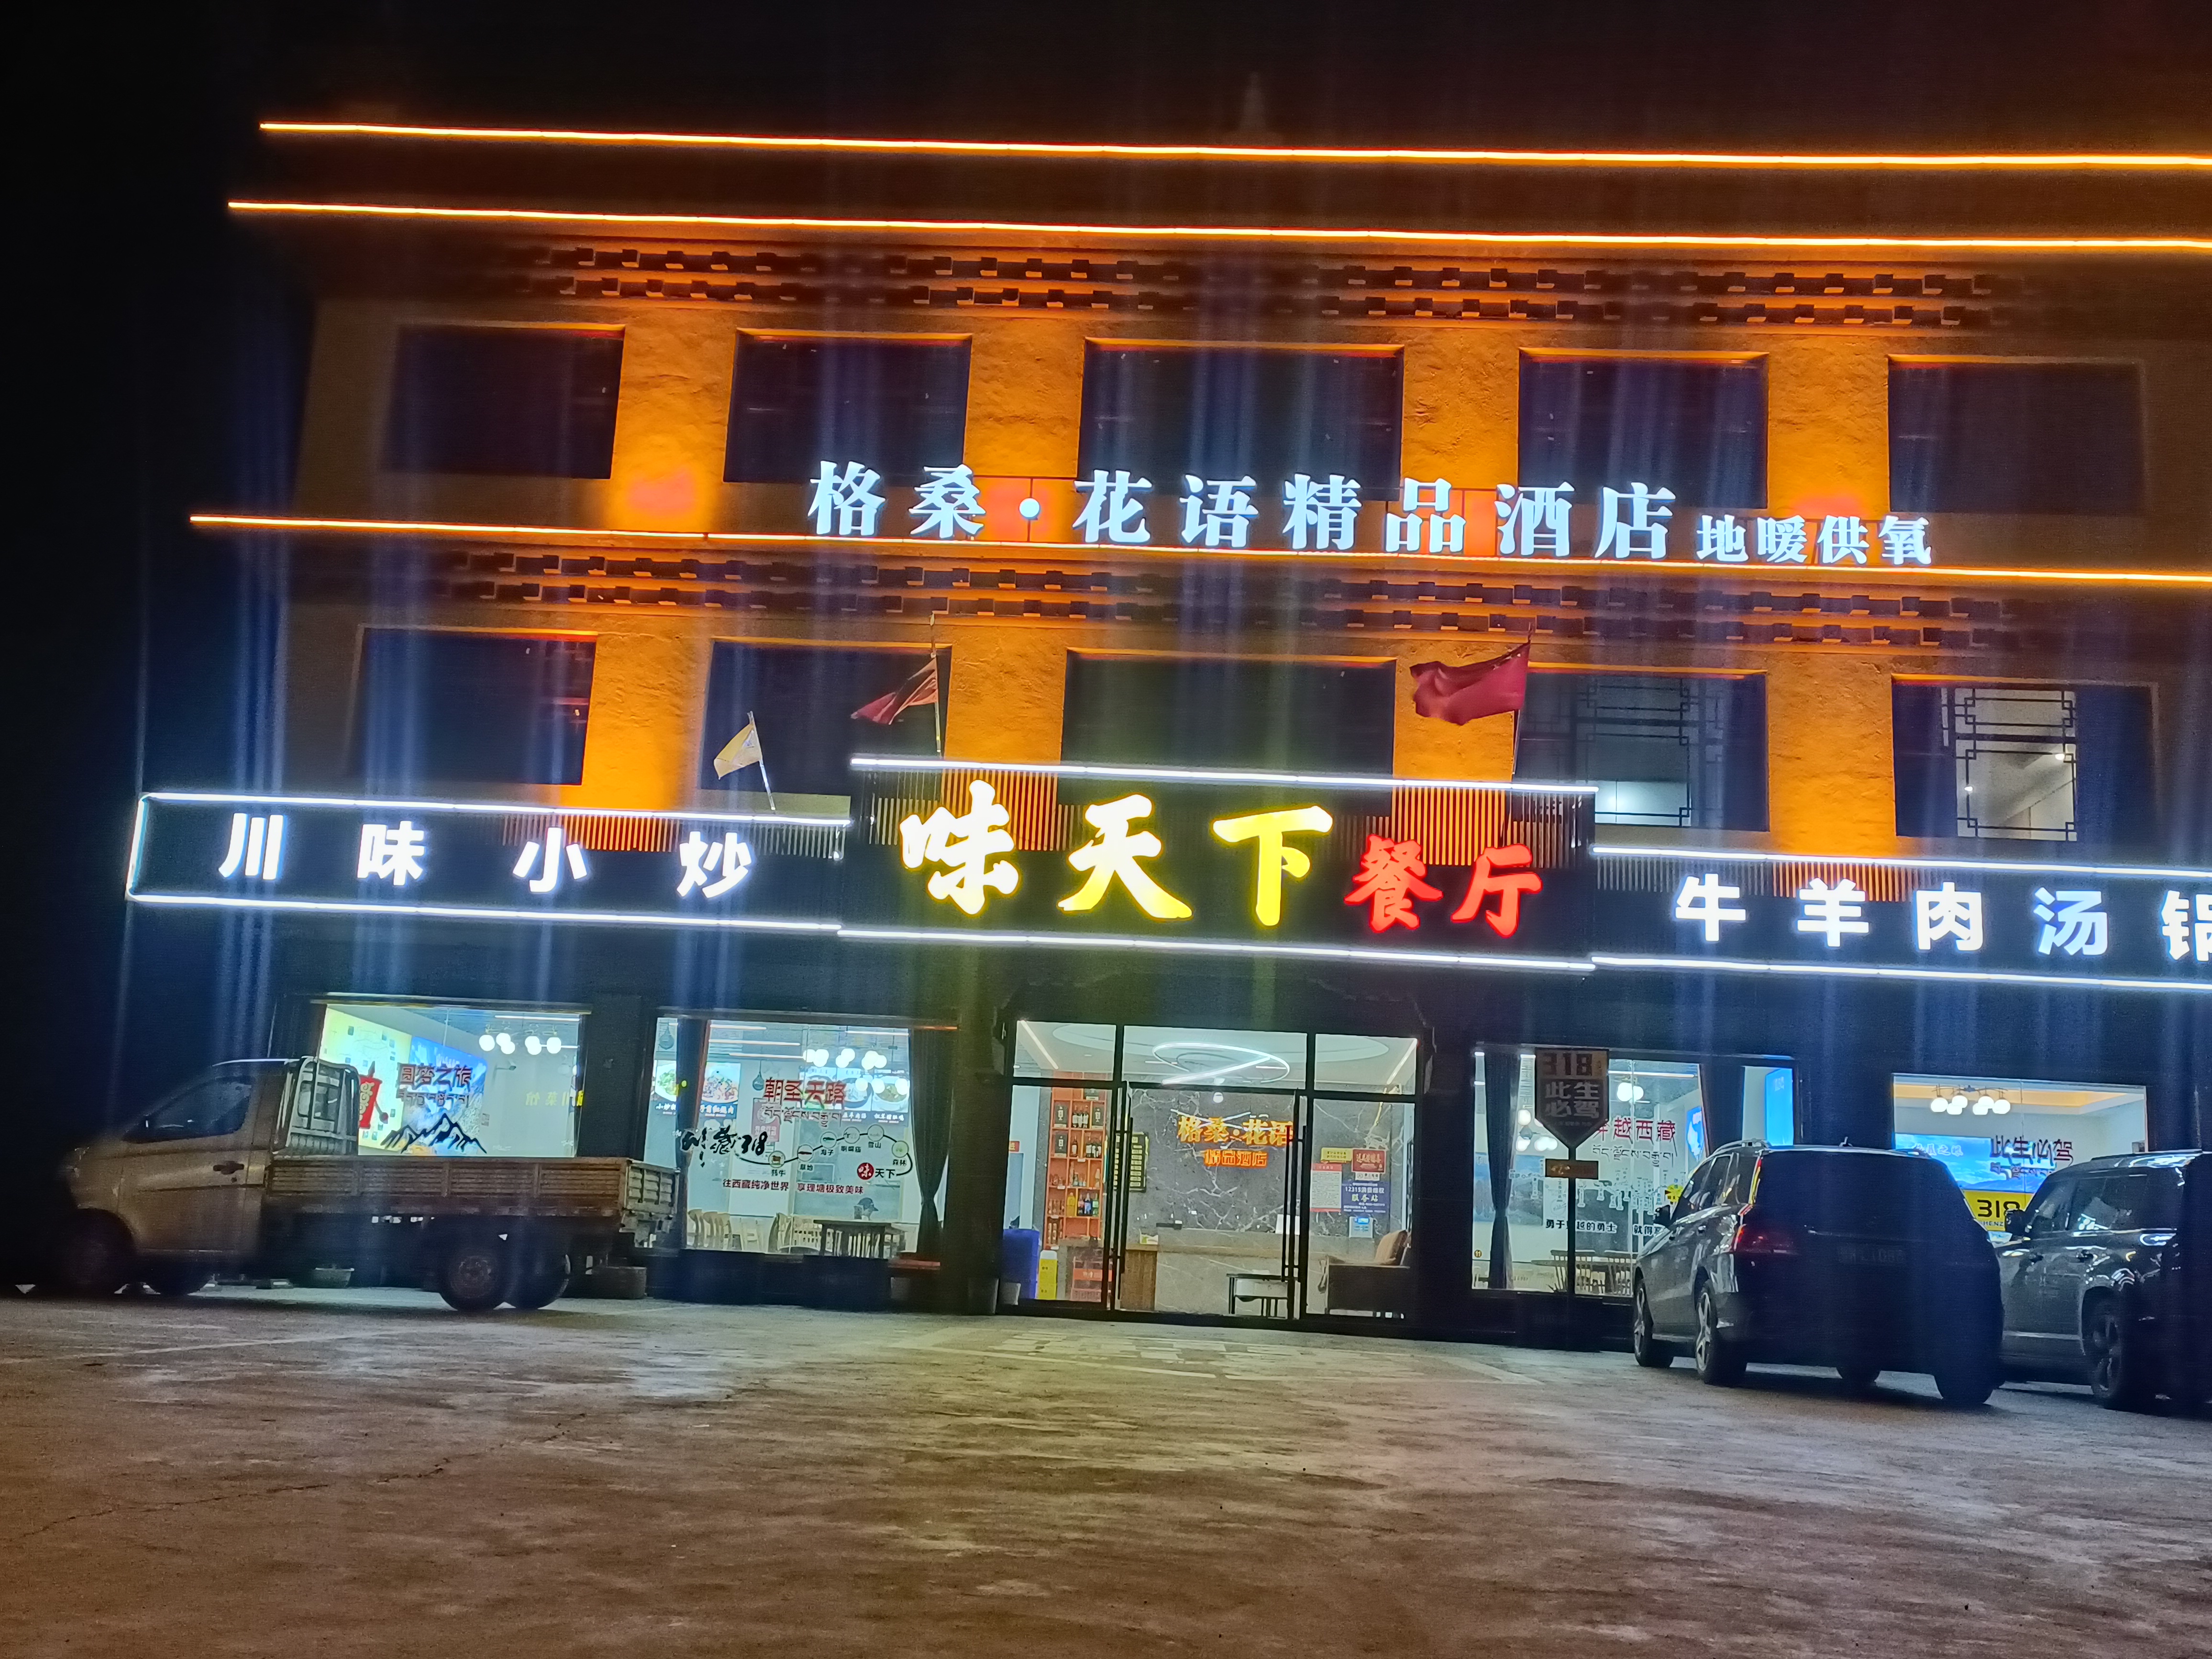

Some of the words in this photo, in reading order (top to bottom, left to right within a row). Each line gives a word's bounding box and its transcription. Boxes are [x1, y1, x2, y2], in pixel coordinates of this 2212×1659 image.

[1696, 514, 1931, 565] 地暖供氧
[220, 813, 753, 898] 川味小炒
[396, 1063, 474, 1092] 圆梦之旅
[1543, 1053, 1593, 1076] 318
[763, 1077, 846, 1108] 朝圣天路
[1205, 1149, 1267, 1167] 精品酒店
[1991, 1135, 2073, 1167] 此生必驾
[1546, 1219, 1616, 1232] 勇于越的勇士
